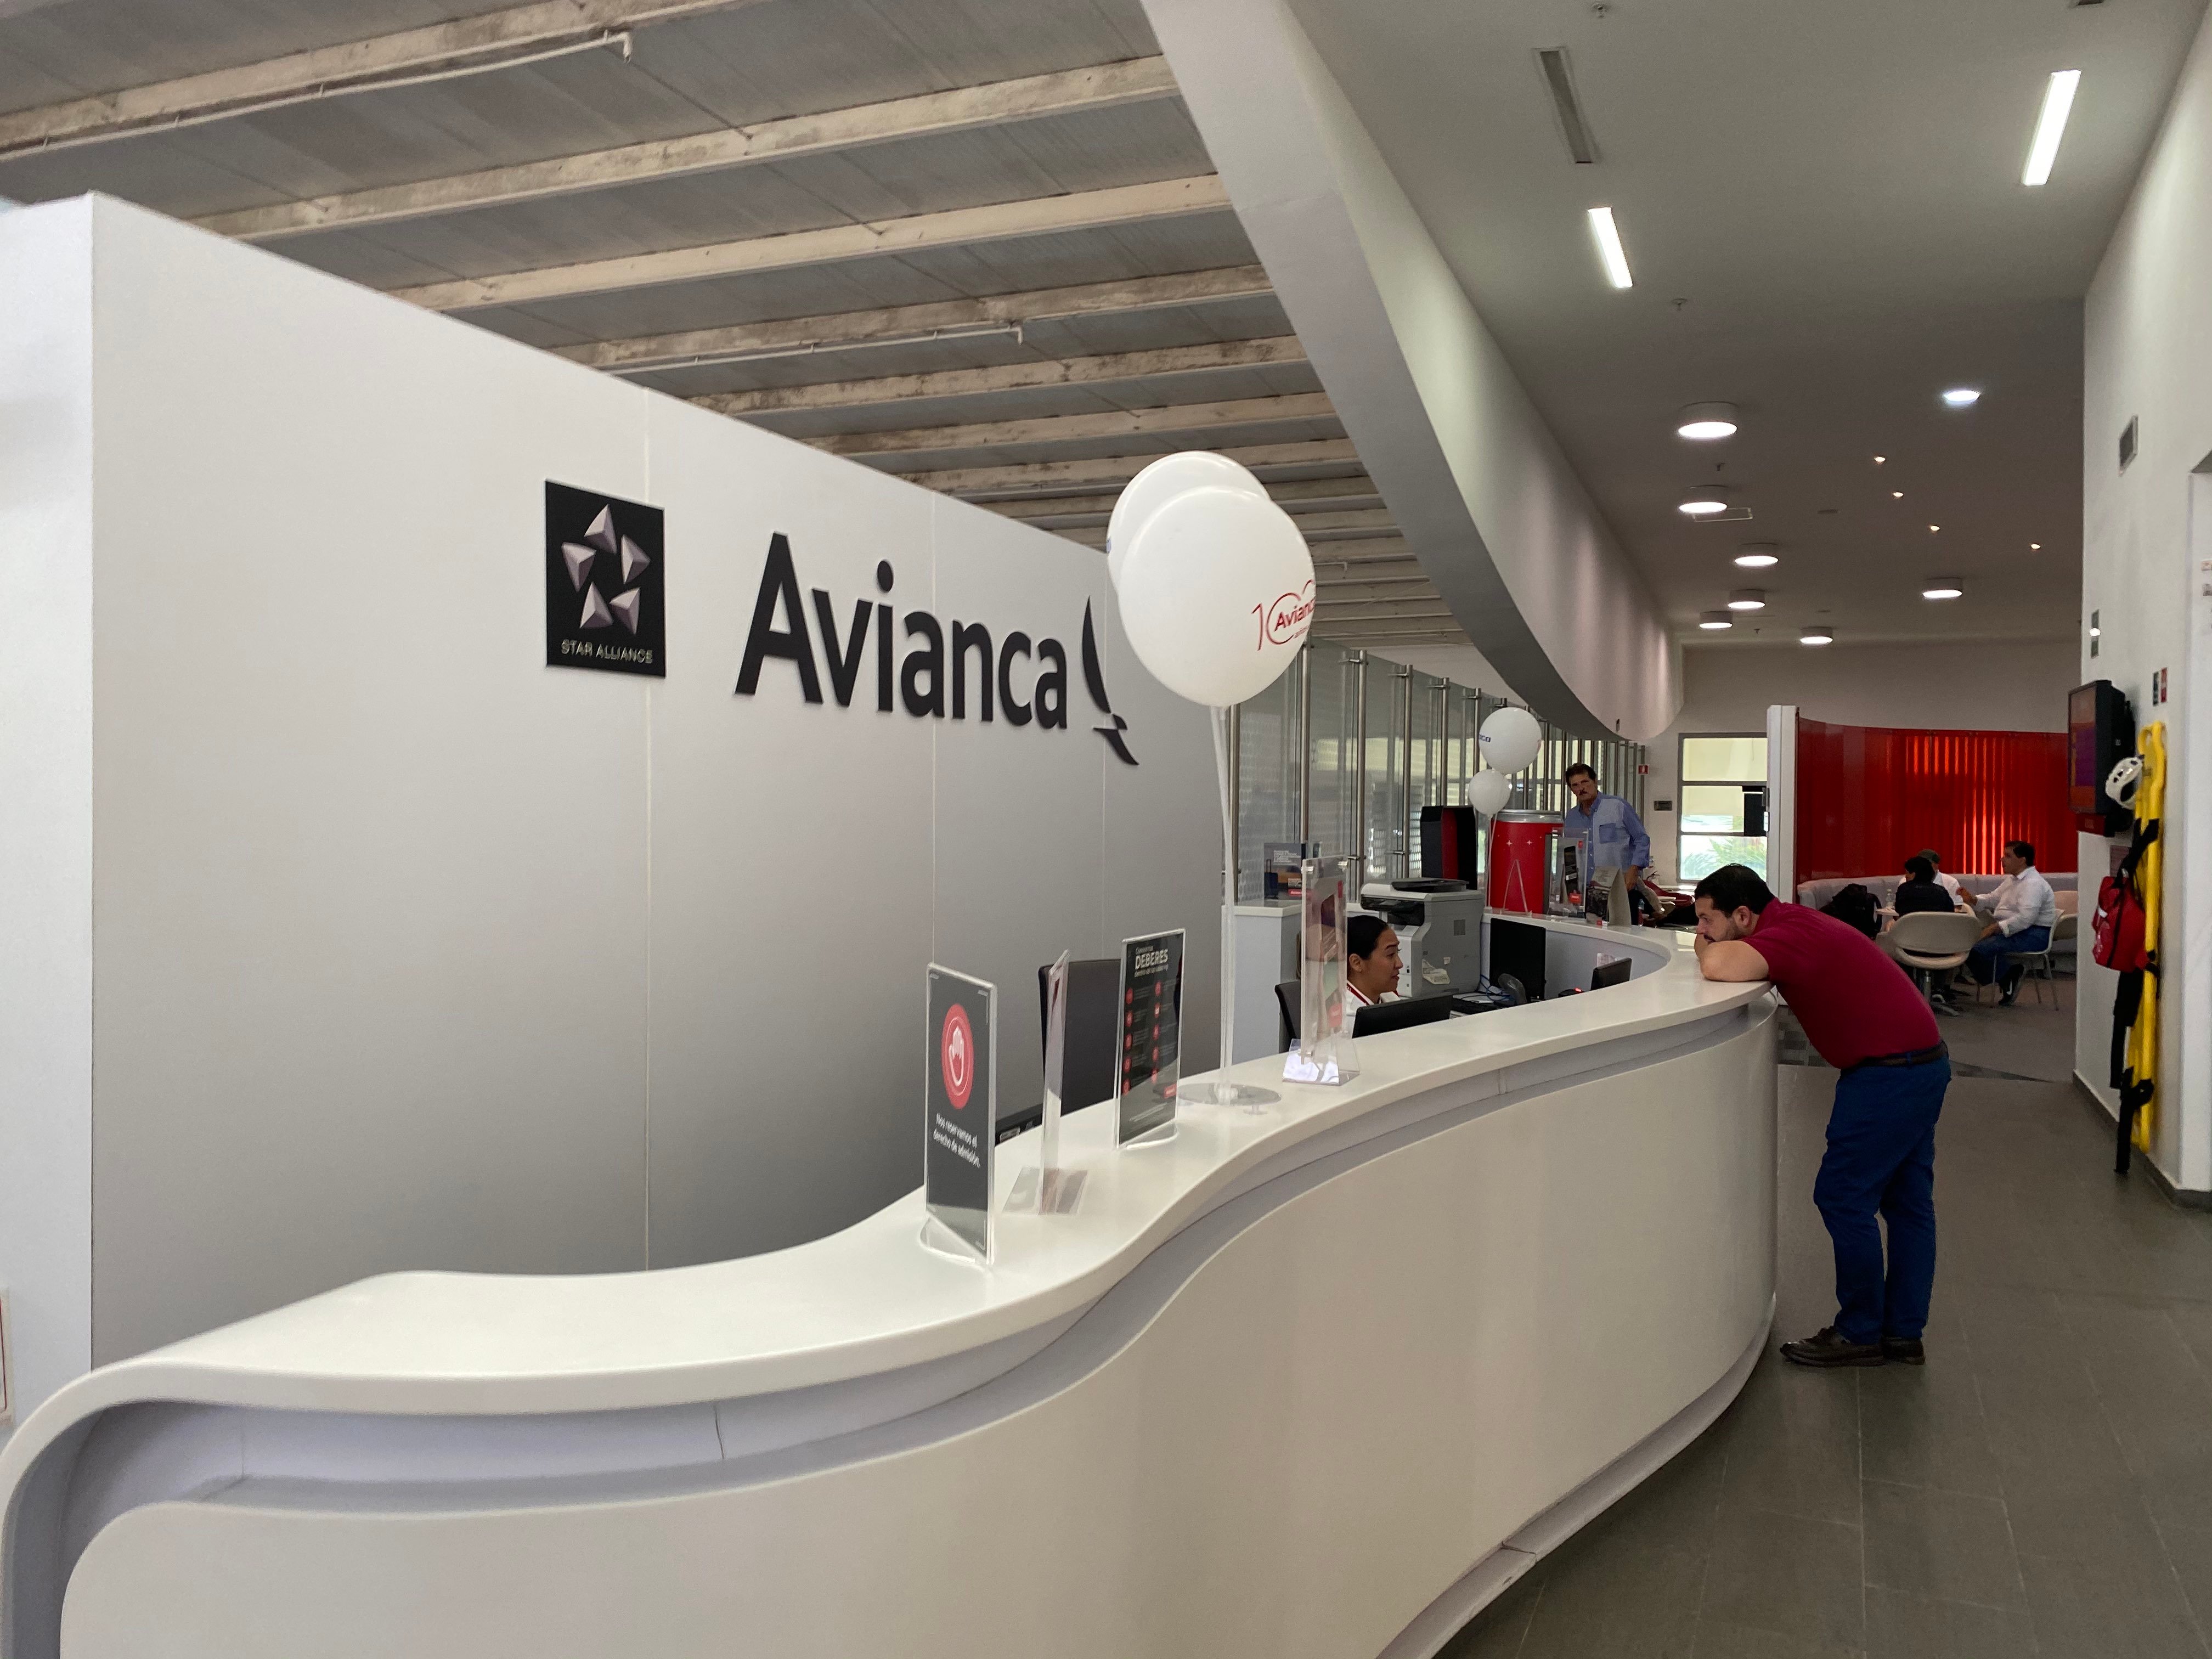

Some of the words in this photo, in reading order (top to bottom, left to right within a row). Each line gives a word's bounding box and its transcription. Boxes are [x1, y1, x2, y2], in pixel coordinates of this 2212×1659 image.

[735, 532, 1068, 730] Avianca
[561, 639, 592, 657] STAR
[596, 644, 653, 664] ALLIANCE
[1135, 949, 1168, 969] DEBERES
